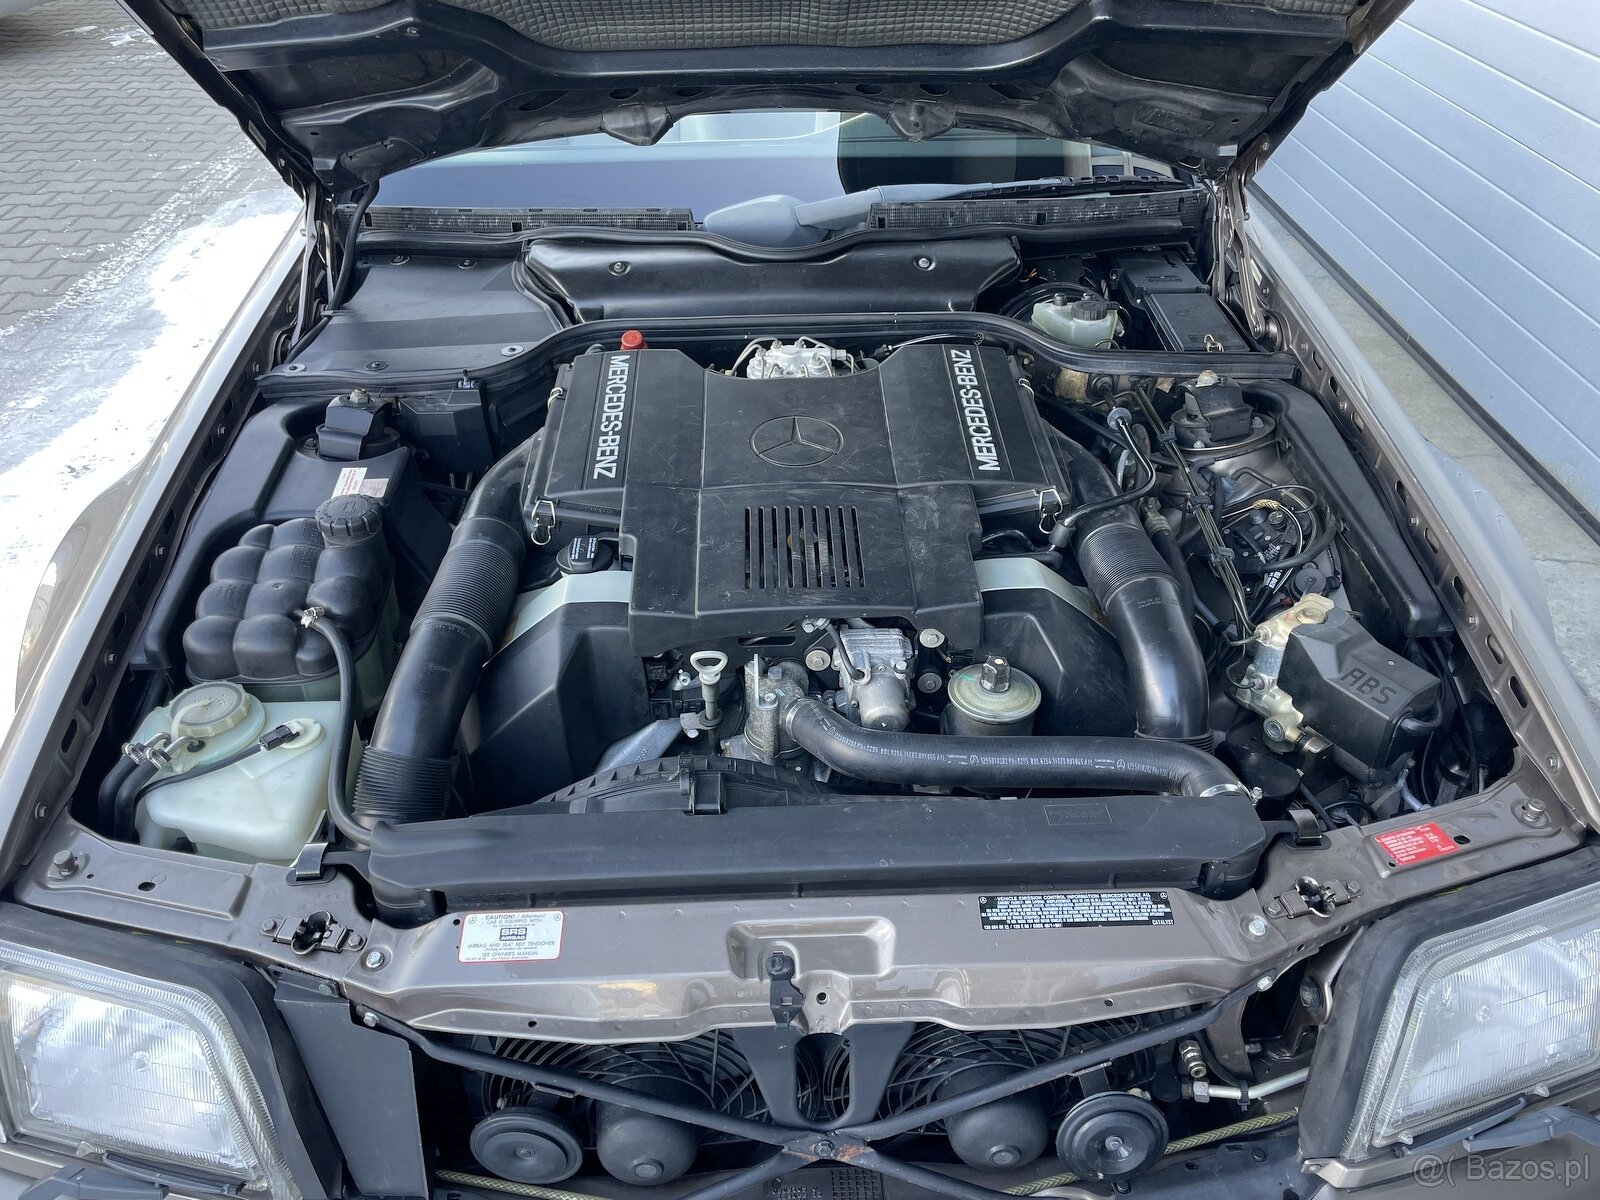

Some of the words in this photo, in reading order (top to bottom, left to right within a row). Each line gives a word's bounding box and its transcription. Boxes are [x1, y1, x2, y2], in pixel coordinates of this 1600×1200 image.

[593, 355, 631, 480] MERCEDES-BENZ
[951, 350, 1000, 470] MERCEDES-BENZ
[1340, 667, 1397, 704] ABS
